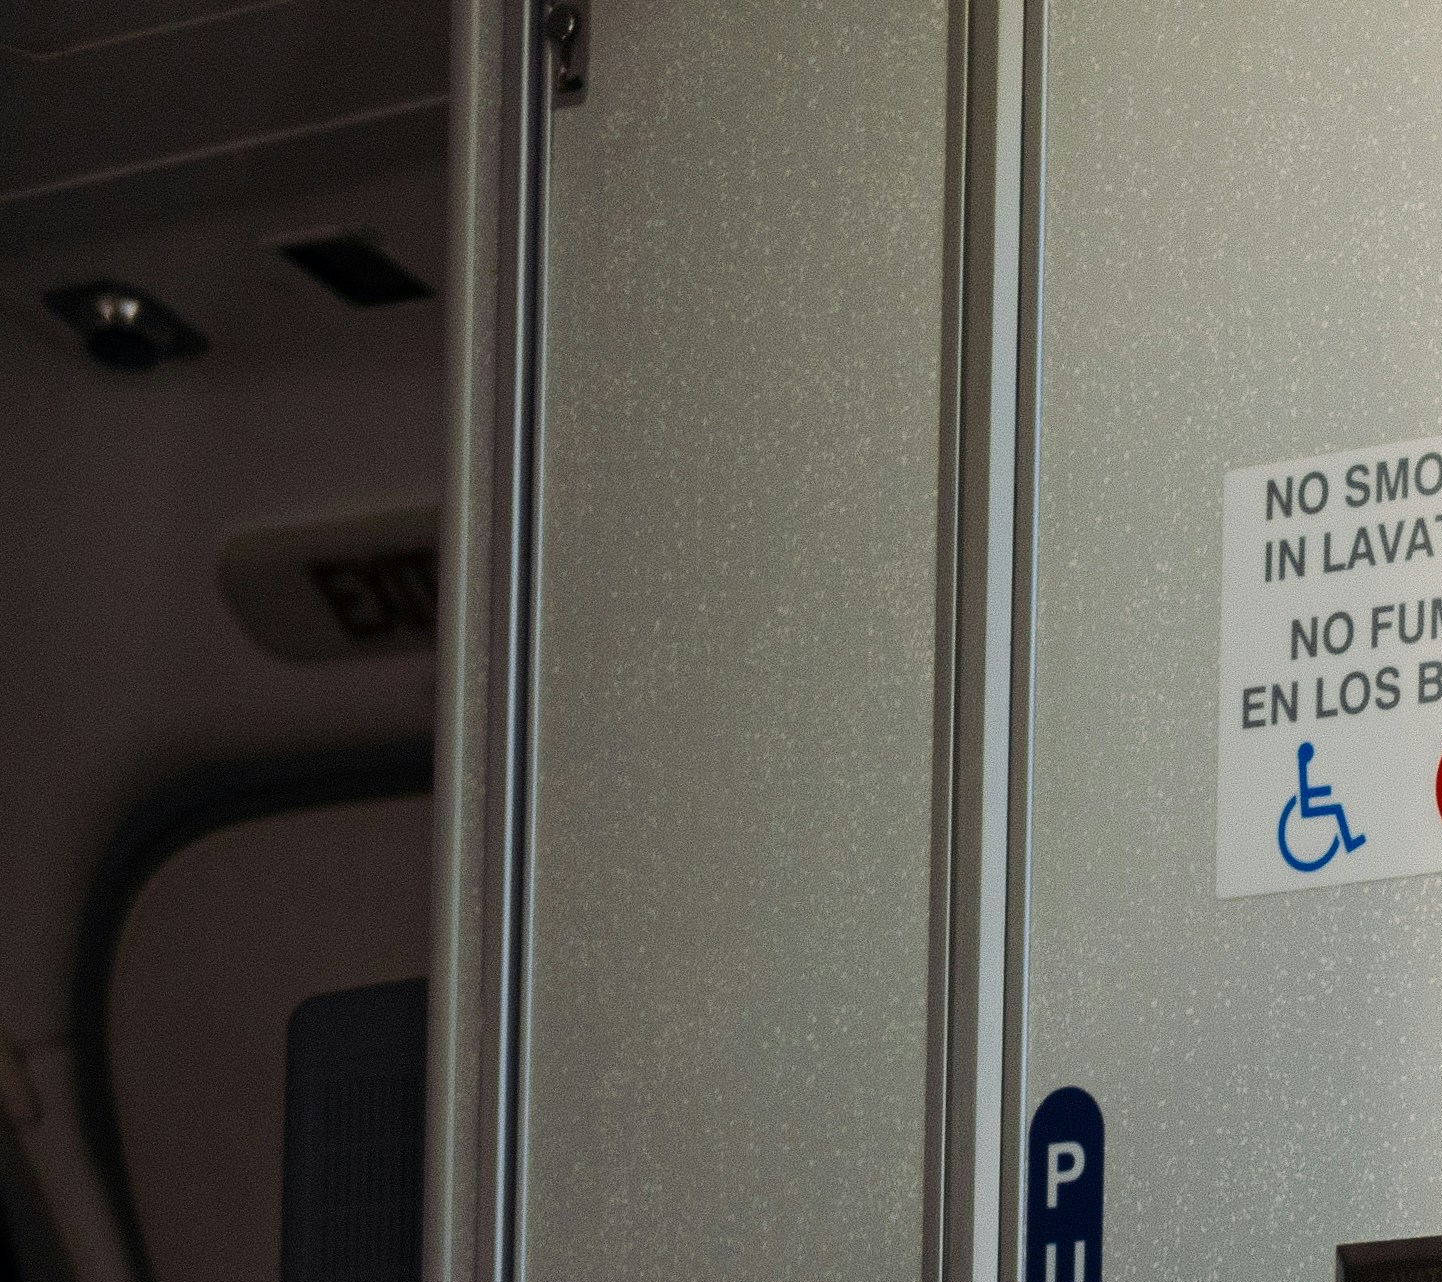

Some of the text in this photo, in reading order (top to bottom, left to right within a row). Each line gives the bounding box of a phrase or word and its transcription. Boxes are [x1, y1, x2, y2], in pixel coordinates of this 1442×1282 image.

[1264, 470, 1330, 522] NO
[1264, 535, 1307, 583] IN
[1290, 610, 1355, 661] NO
[1241, 680, 1299, 731] EN
[1315, 665, 1401, 720] LOS
